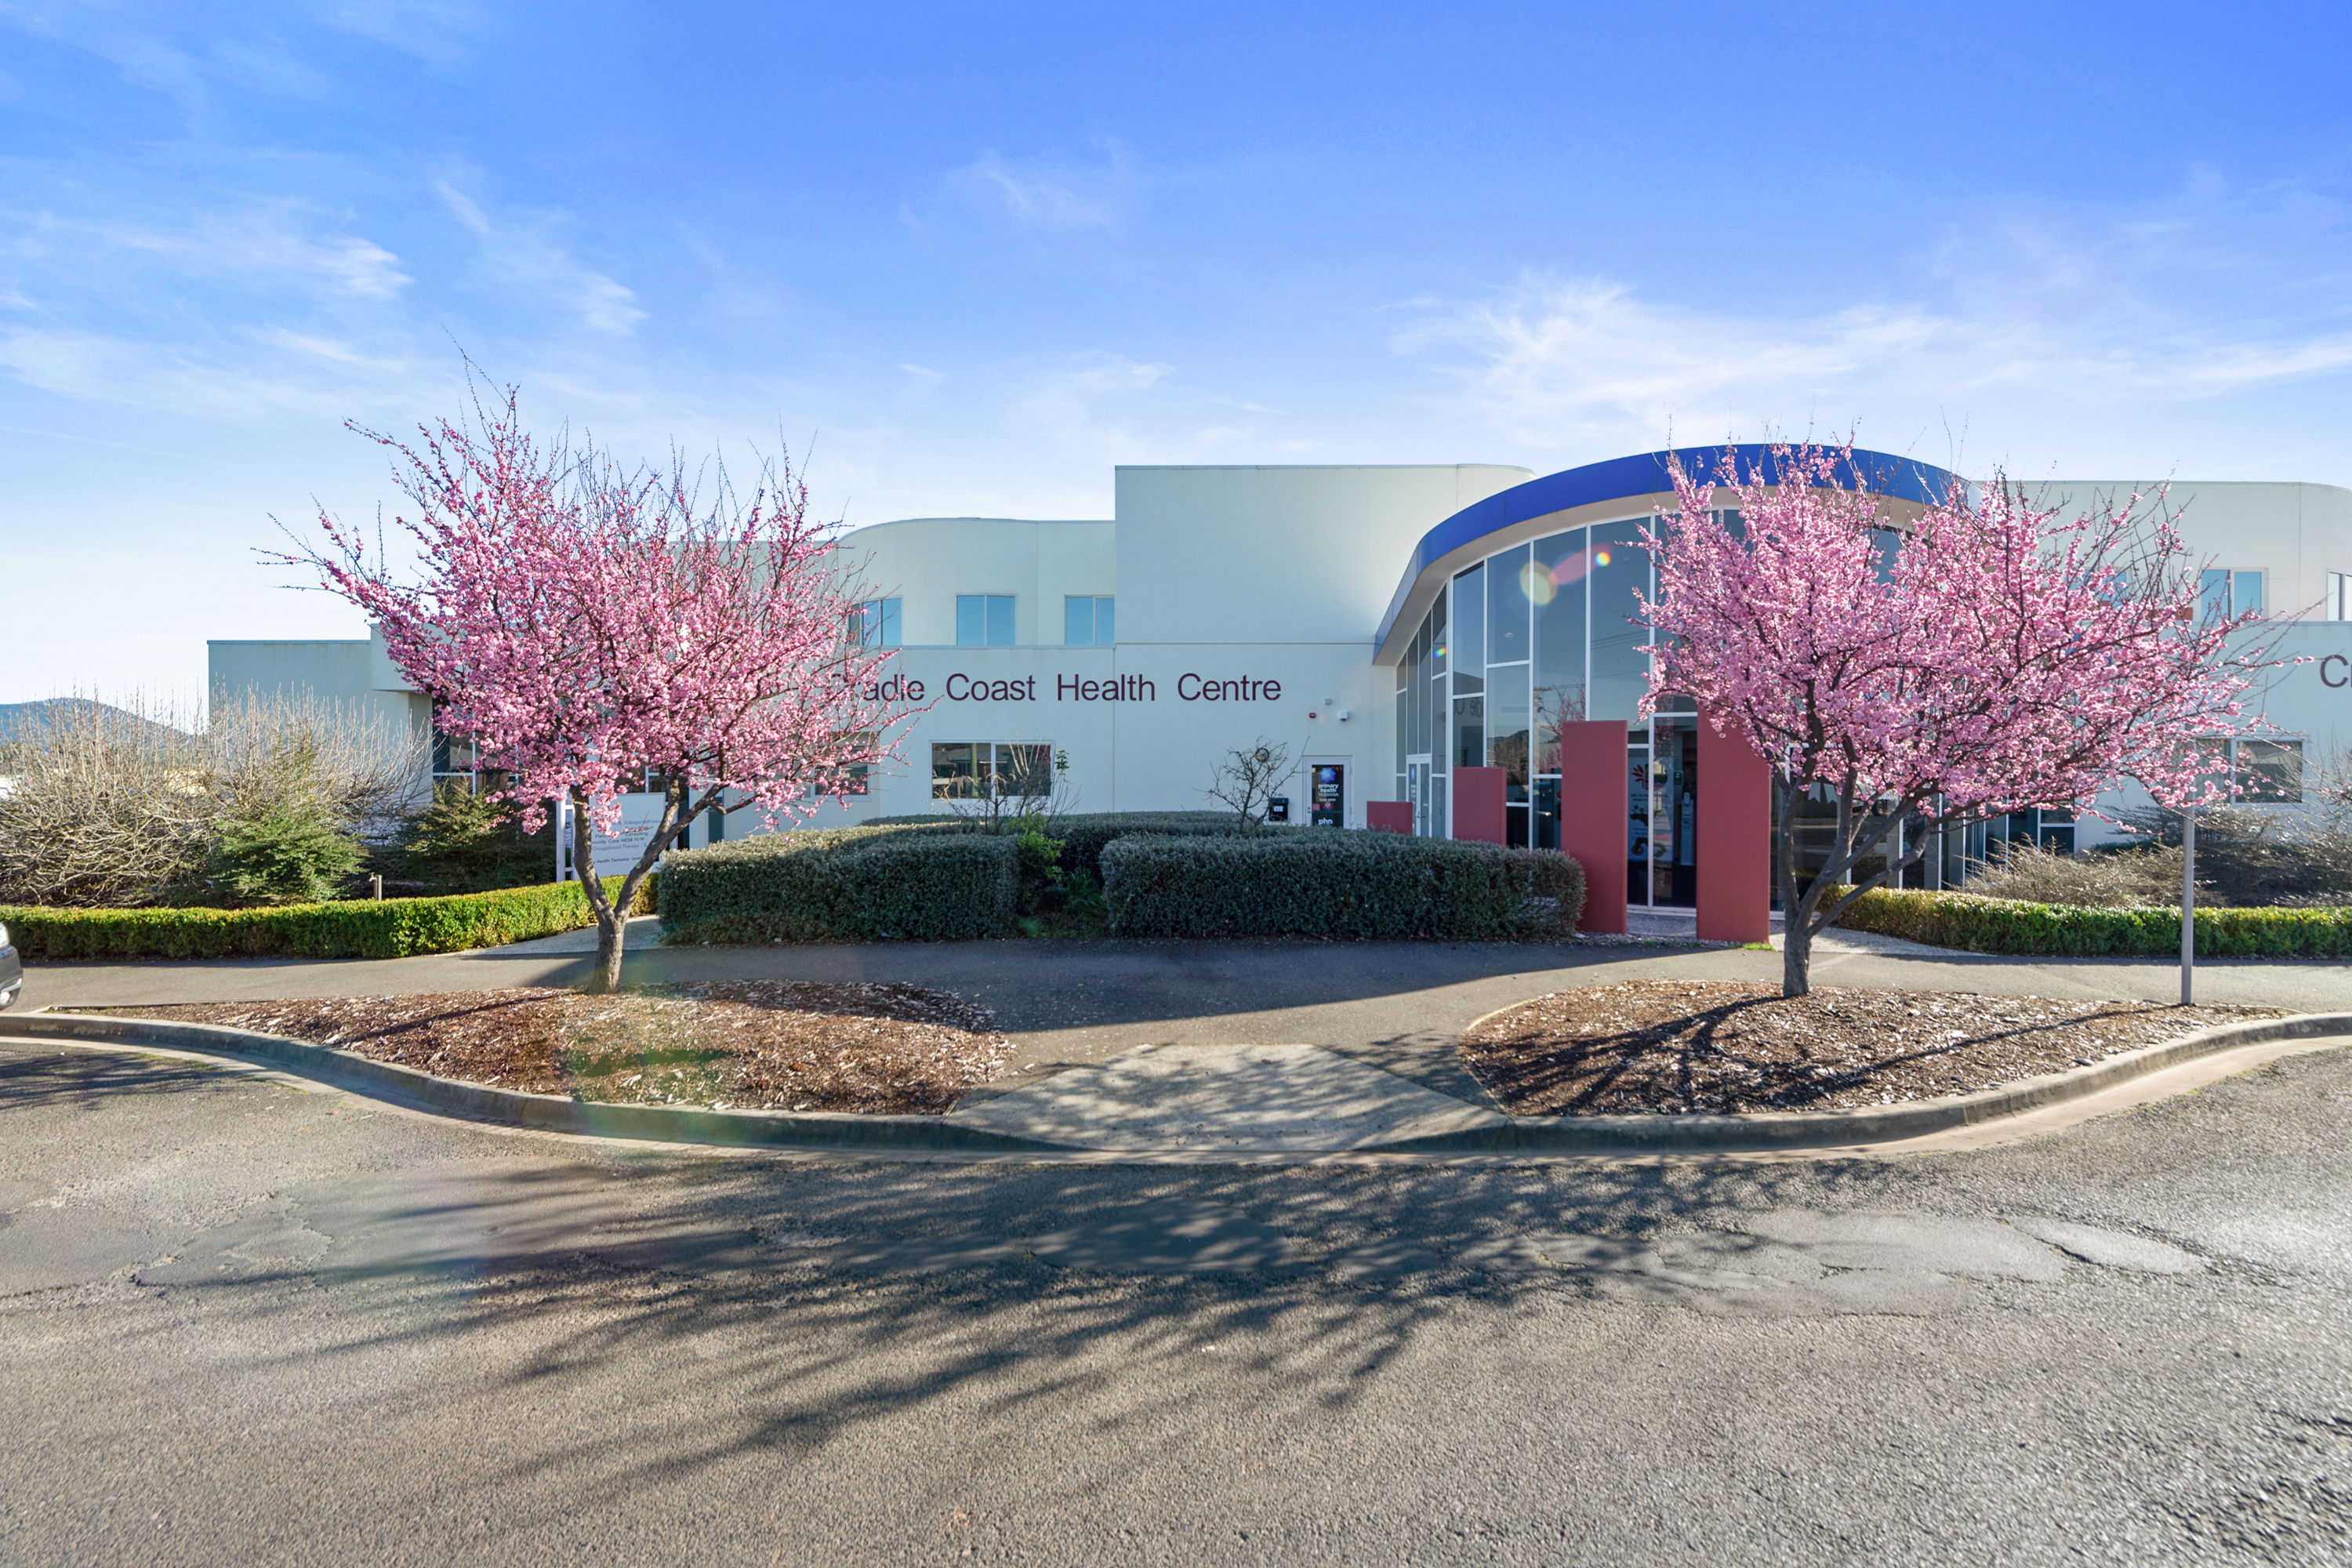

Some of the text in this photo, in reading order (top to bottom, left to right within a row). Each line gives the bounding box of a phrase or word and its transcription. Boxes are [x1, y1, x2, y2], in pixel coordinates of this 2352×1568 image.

[2320, 654, 2352, 688] C
[946, 673, 1036, 702] Coast
[1057, 673, 1156, 702] Health
[1178, 673, 1282, 702] Centre
